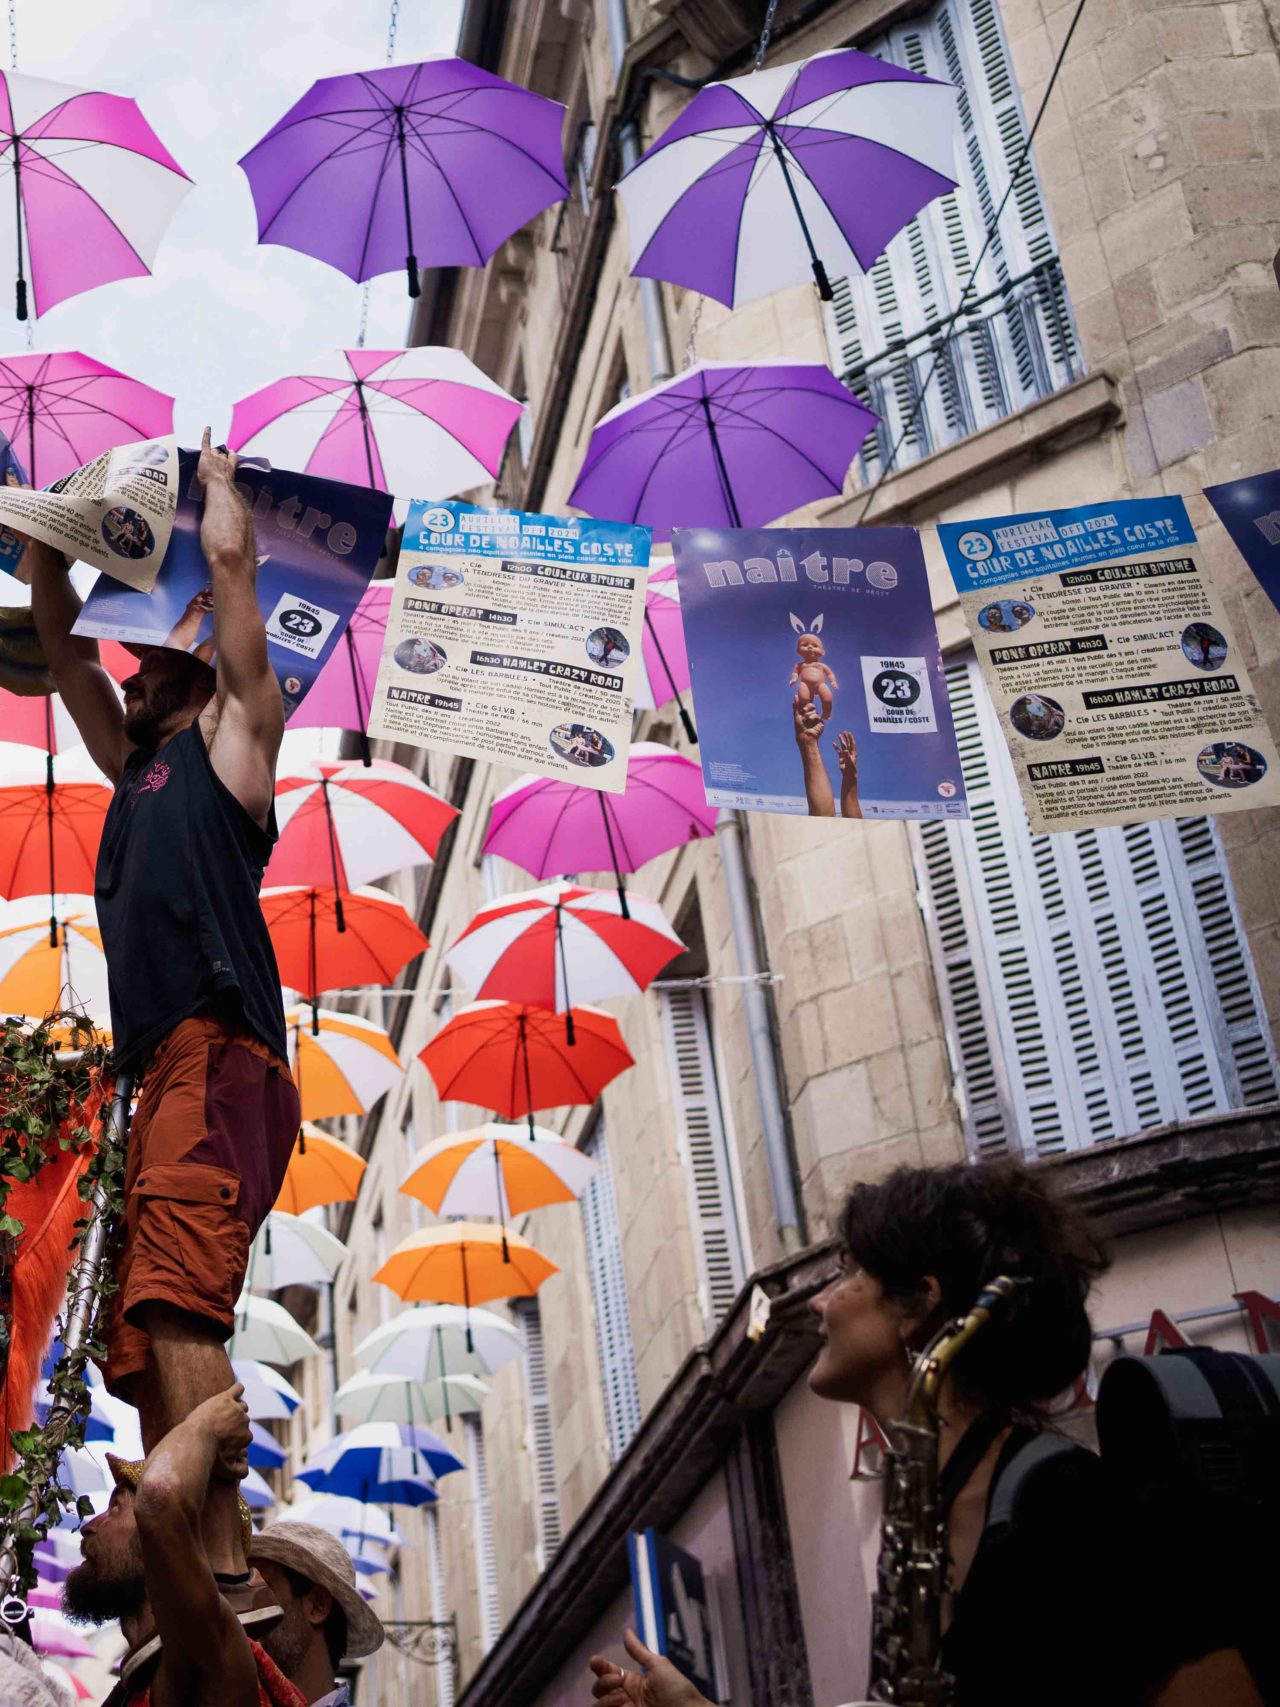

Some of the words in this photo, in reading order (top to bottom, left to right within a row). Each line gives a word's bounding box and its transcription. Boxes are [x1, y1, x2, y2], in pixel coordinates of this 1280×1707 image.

[428, 512, 449, 526] 23
[995, 520, 1051, 538] AURILLAC
[999, 531, 1056, 549] FESTIVAL
[1061, 524, 1081, 536] OFF
[1087, 516, 1115, 529] 2024
[418, 531, 465, 546] COUR
[468, 534, 491, 547] DE
[495, 535, 574, 552] NOAILLES
[579, 542, 634, 556] COSTE
[962, 537, 989, 555] 23
[965, 555, 1013, 578] COUR
[1014, 549, 1039, 567] DE
[1039, 529, 1121, 561] NOAILLES
[1122, 518, 1178, 542] COSTE
[472, 569, 515, 579] TENDRESSE
[533, 578, 565, 587] GRAVIER
[537, 566, 588, 581] COULEUR
[590, 574, 630, 587] BITUME
[1066, 574, 1092, 583] 12h00
[1096, 564, 1149, 580] COULEUR
[1149, 559, 1191, 574] BITUME
[1036, 588, 1082, 599] TENDRESSE
[1098, 582, 1132, 591] GRAVIER
[298, 602, 320, 616] 19H45
[407, 599, 438, 612] PONK
[440, 603, 483, 618] OPERAT
[488, 613, 512, 622] 14h30
[285, 614, 314, 633] 23
[280, 631, 296, 640] COUR
[1132, 630, 1175, 641] SIMUL'ACT
[296, 642, 314, 653] COSTE
[993, 647, 1028, 661] PONK
[1027, 640, 1073, 656] OPERAT
[1077, 639, 1102, 649] 14h30
[476, 655, 500, 663] 16h30
[502, 656, 546, 671] HAMLET
[548, 664, 587, 680] CRAZY
[589, 672, 620, 688] ROAD
[880, 660, 905, 668] 19H45
[881, 678, 911, 699] 23
[1088, 694, 1114, 704] 16h30
[1114, 687, 1160, 703] HAMLET
[1160, 682, 1202, 697] CRAZY
[1202, 678, 1236, 692] ROAD
[434, 699, 459, 708] 19h45
[886, 708, 904, 716] COUR
[906, 708, 914, 716] DE
[1075, 763, 1100, 772] 19h45
